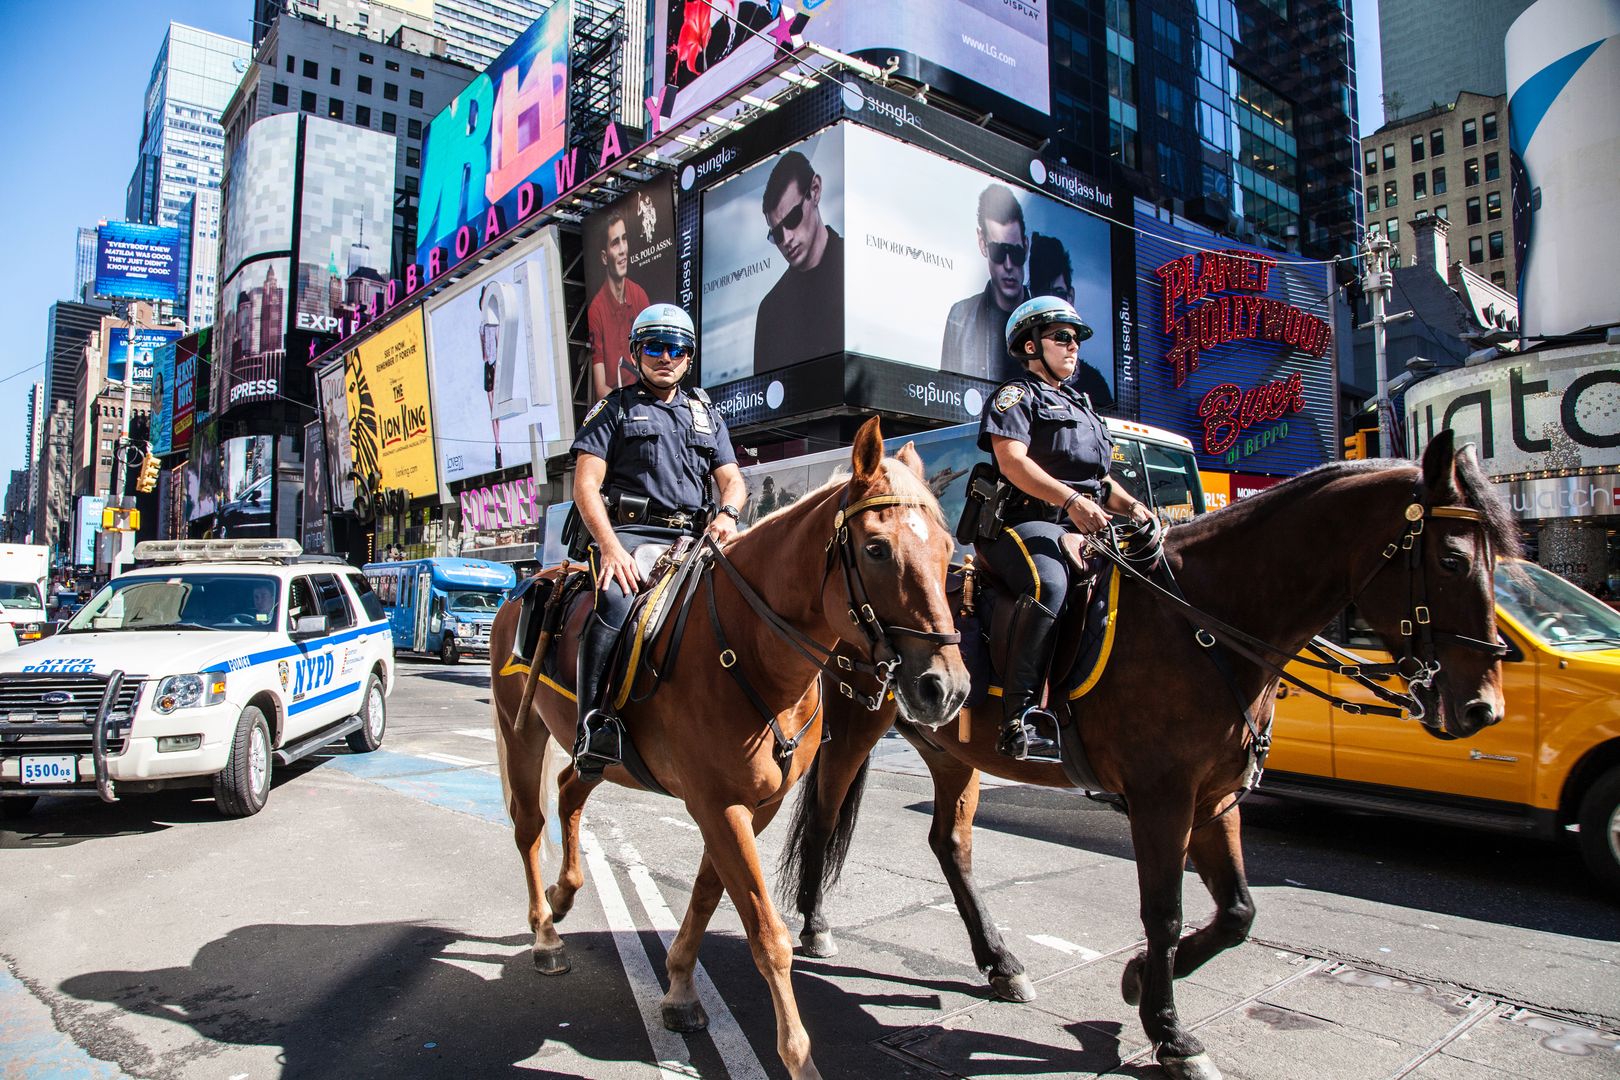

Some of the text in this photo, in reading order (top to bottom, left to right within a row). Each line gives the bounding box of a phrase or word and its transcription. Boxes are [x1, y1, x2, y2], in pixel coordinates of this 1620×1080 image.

[961, 33, 1016, 67] www.LG.com
[406, 86, 667, 294] BROADWAY
[1048, 171, 1113, 209] sunglass hut
[104, 249, 134, 257] MATILDA
[151, 253, 173, 262] GOOD,
[144, 259, 168, 267] DIDN'T
[149, 245, 171, 253] KNEW
[630, 238, 673, 264] U.S. POLO ASSN.
[866, 233, 954, 271] EMPORIO ARMANI
[107, 263, 129, 271] KNOW
[130, 265, 147, 273] HOW
[680, 227, 693, 313] nglass hut
[703, 258, 771, 294] EMPORIO ARMANI
[1156, 250, 1278, 335] PLANET
[1166, 296, 1332, 388] HOLLYWOOD
[230, 378, 278, 403] EXPRESS
[393, 384, 404, 399] THE
[379, 414, 401, 449] LION
[401, 404, 426, 441] KING
[1245, 422, 1289, 458] BEPPO
[460, 476, 539, 534] FOREVER
[1204, 491, 1228, 508] RL'S
[22, 664, 96, 673] POLICE
[228, 655, 250, 672] POLICE
[293, 653, 334, 695] NYPD
[25, 763, 59, 779] 5500
